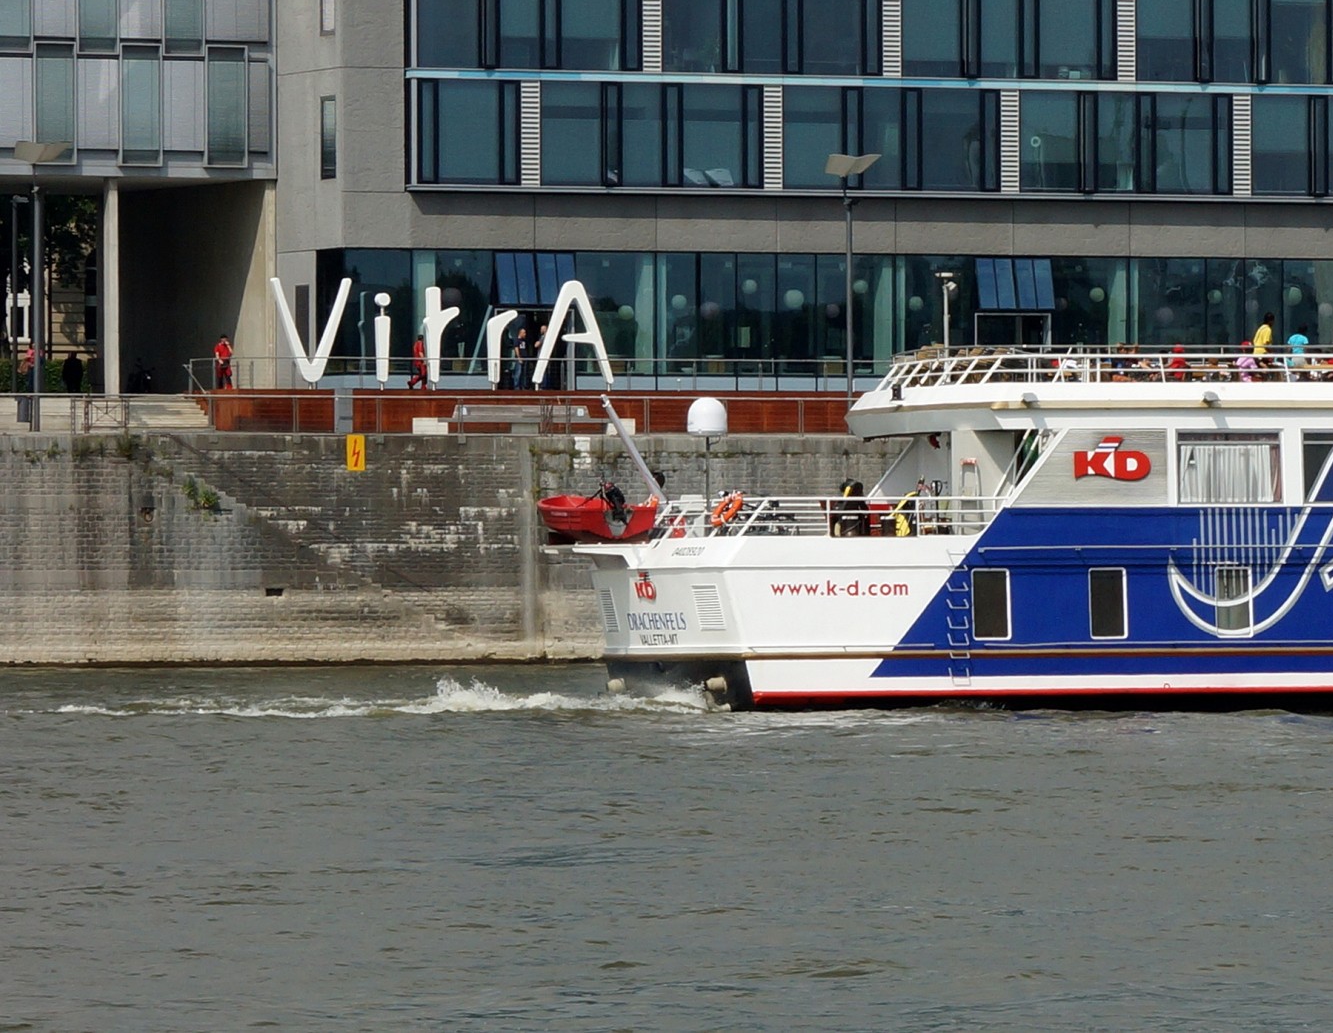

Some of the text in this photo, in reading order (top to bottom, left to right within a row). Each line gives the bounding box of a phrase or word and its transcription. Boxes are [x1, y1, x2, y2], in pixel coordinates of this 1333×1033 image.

[1073, 446, 1152, 482] KD
[770, 579, 910, 597] www.k-d.com
[627, 612, 687, 631] DRACHENFELS
